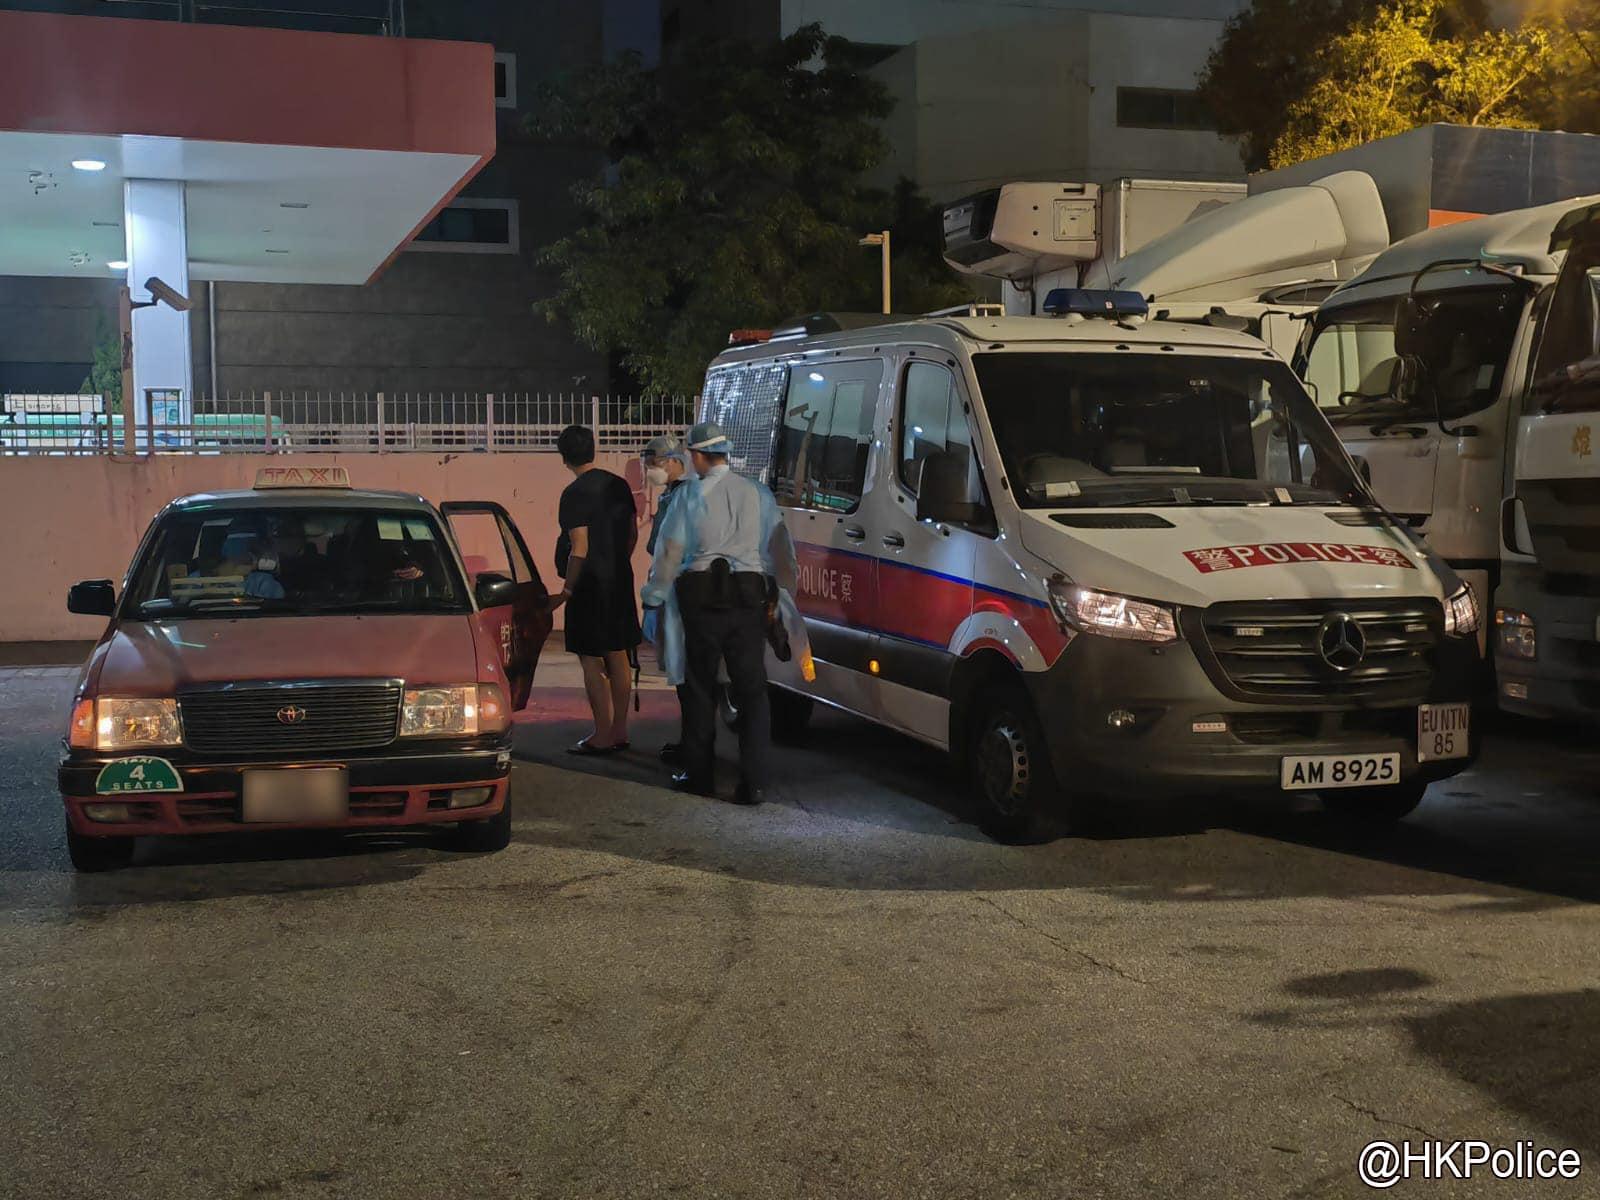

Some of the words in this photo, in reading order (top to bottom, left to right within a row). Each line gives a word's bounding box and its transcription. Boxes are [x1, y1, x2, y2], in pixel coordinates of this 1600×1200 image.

[265, 468, 341, 485] TAXI
[1194, 548, 1234, 571] 警
[1229, 544, 1379, 566] POLICE
[1371, 547, 1412, 568] 察
[1433, 733, 1455, 756] 85
[129, 765, 145, 781] 4
[1291, 761, 1324, 784] AM
[1332, 757, 1394, 783] 8925
[112, 781, 163, 791] SEATS
